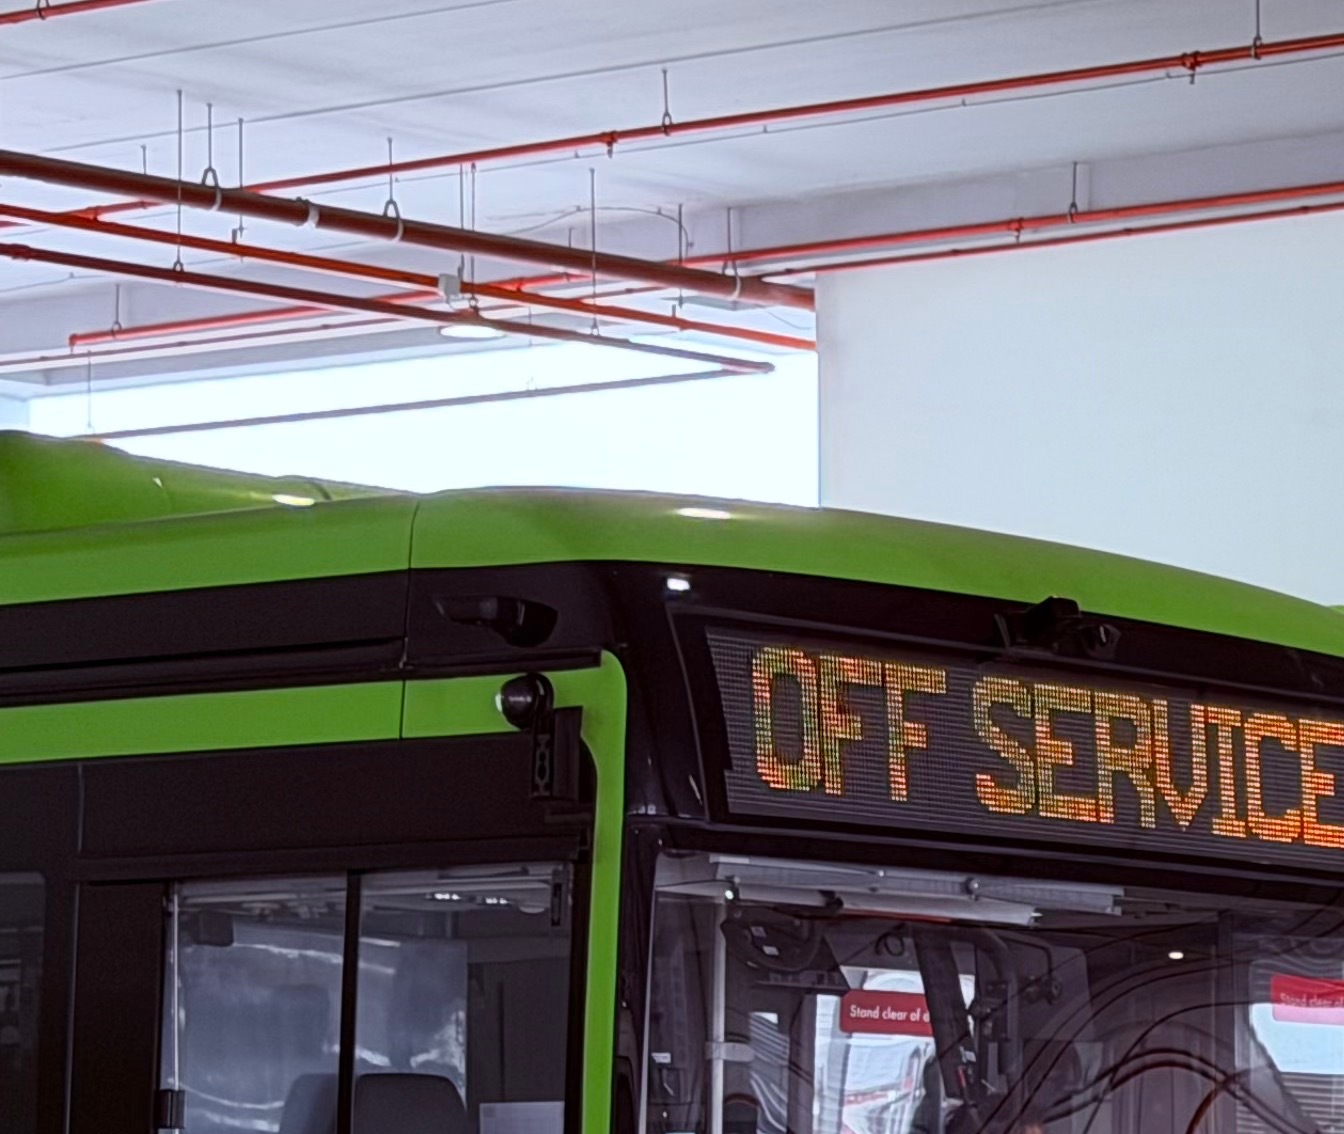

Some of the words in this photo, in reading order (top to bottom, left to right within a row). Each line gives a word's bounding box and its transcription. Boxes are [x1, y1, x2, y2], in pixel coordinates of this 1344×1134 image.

[752, 647, 946, 801] OFF
[849, 1004, 880, 1019] Stand
[882, 1006, 908, 1021] clear
[909, 1008, 921, 1022] of
